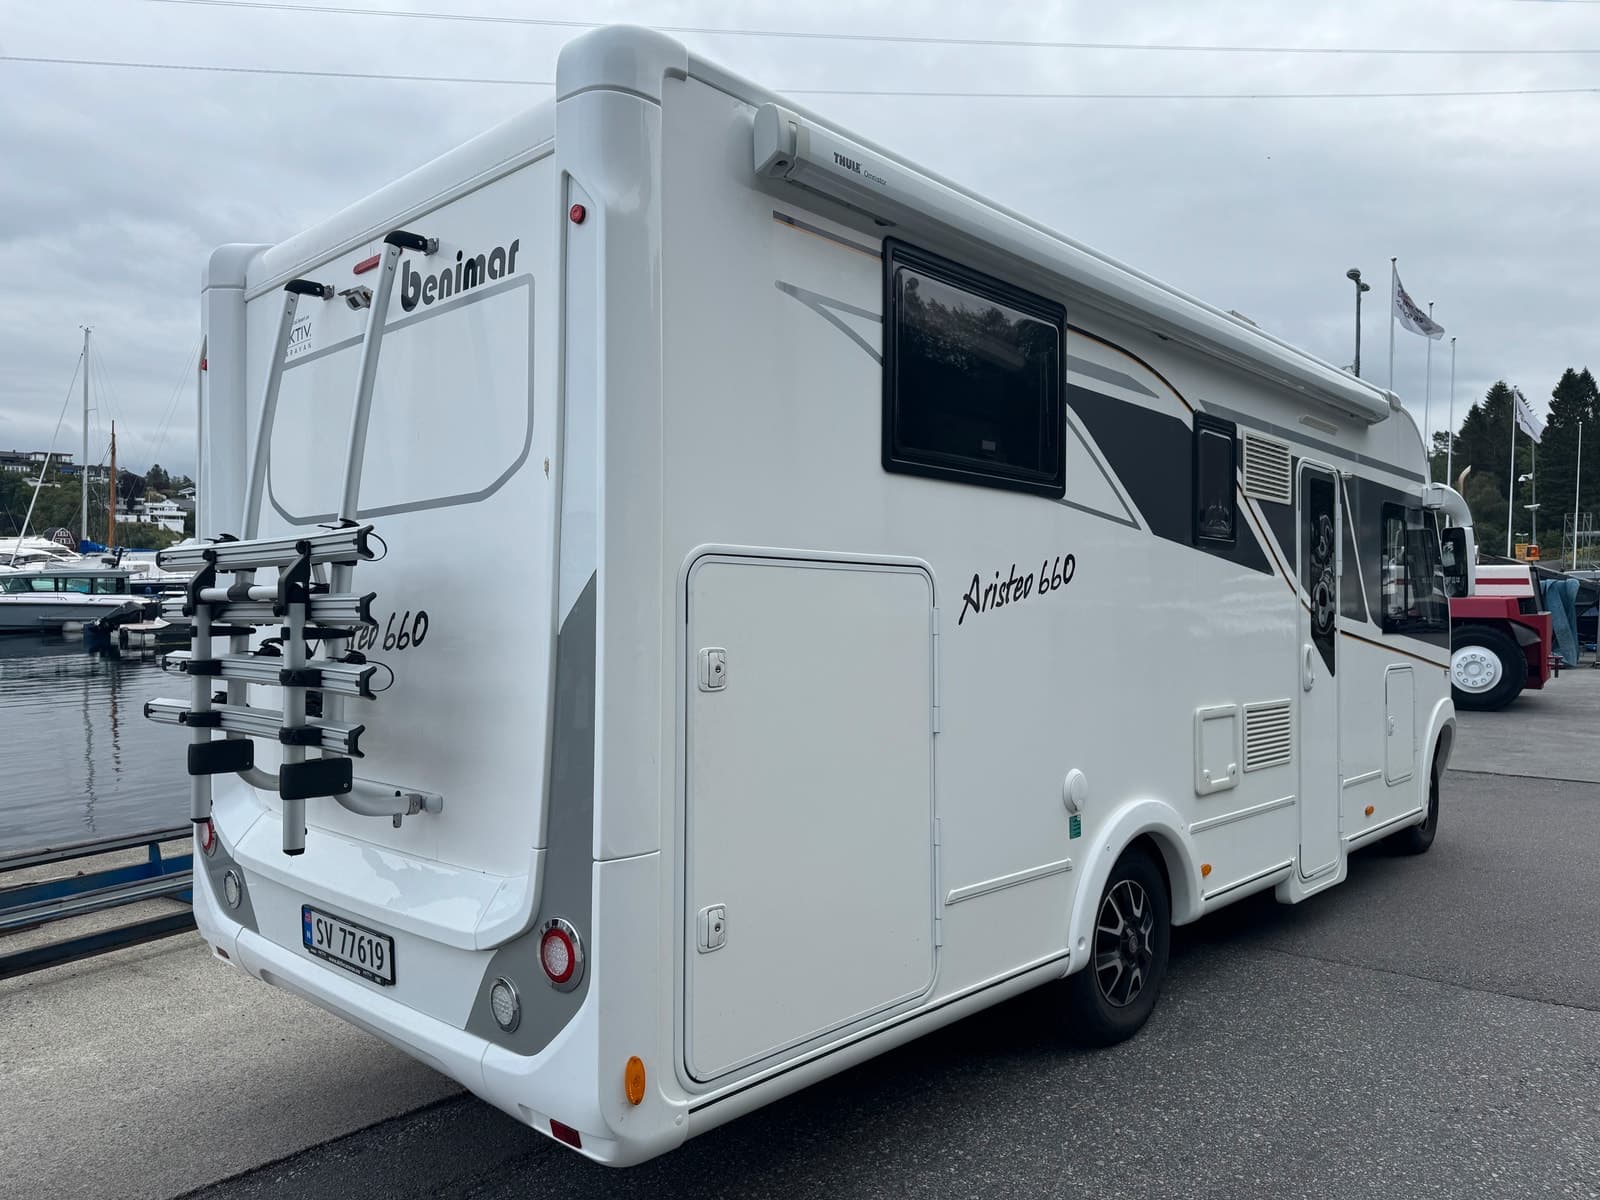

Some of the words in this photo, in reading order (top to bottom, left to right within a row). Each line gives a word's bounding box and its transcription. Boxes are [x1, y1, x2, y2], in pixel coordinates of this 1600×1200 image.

[833, 151, 861, 174] THULE
[401, 239, 520, 312] benimar
[958, 563, 1033, 625] Aristeo
[1038, 553, 1076, 594] 660
[382, 610, 429, 651] 660
[316, 918, 333, 949] SV
[339, 927, 384, 970] 77619
